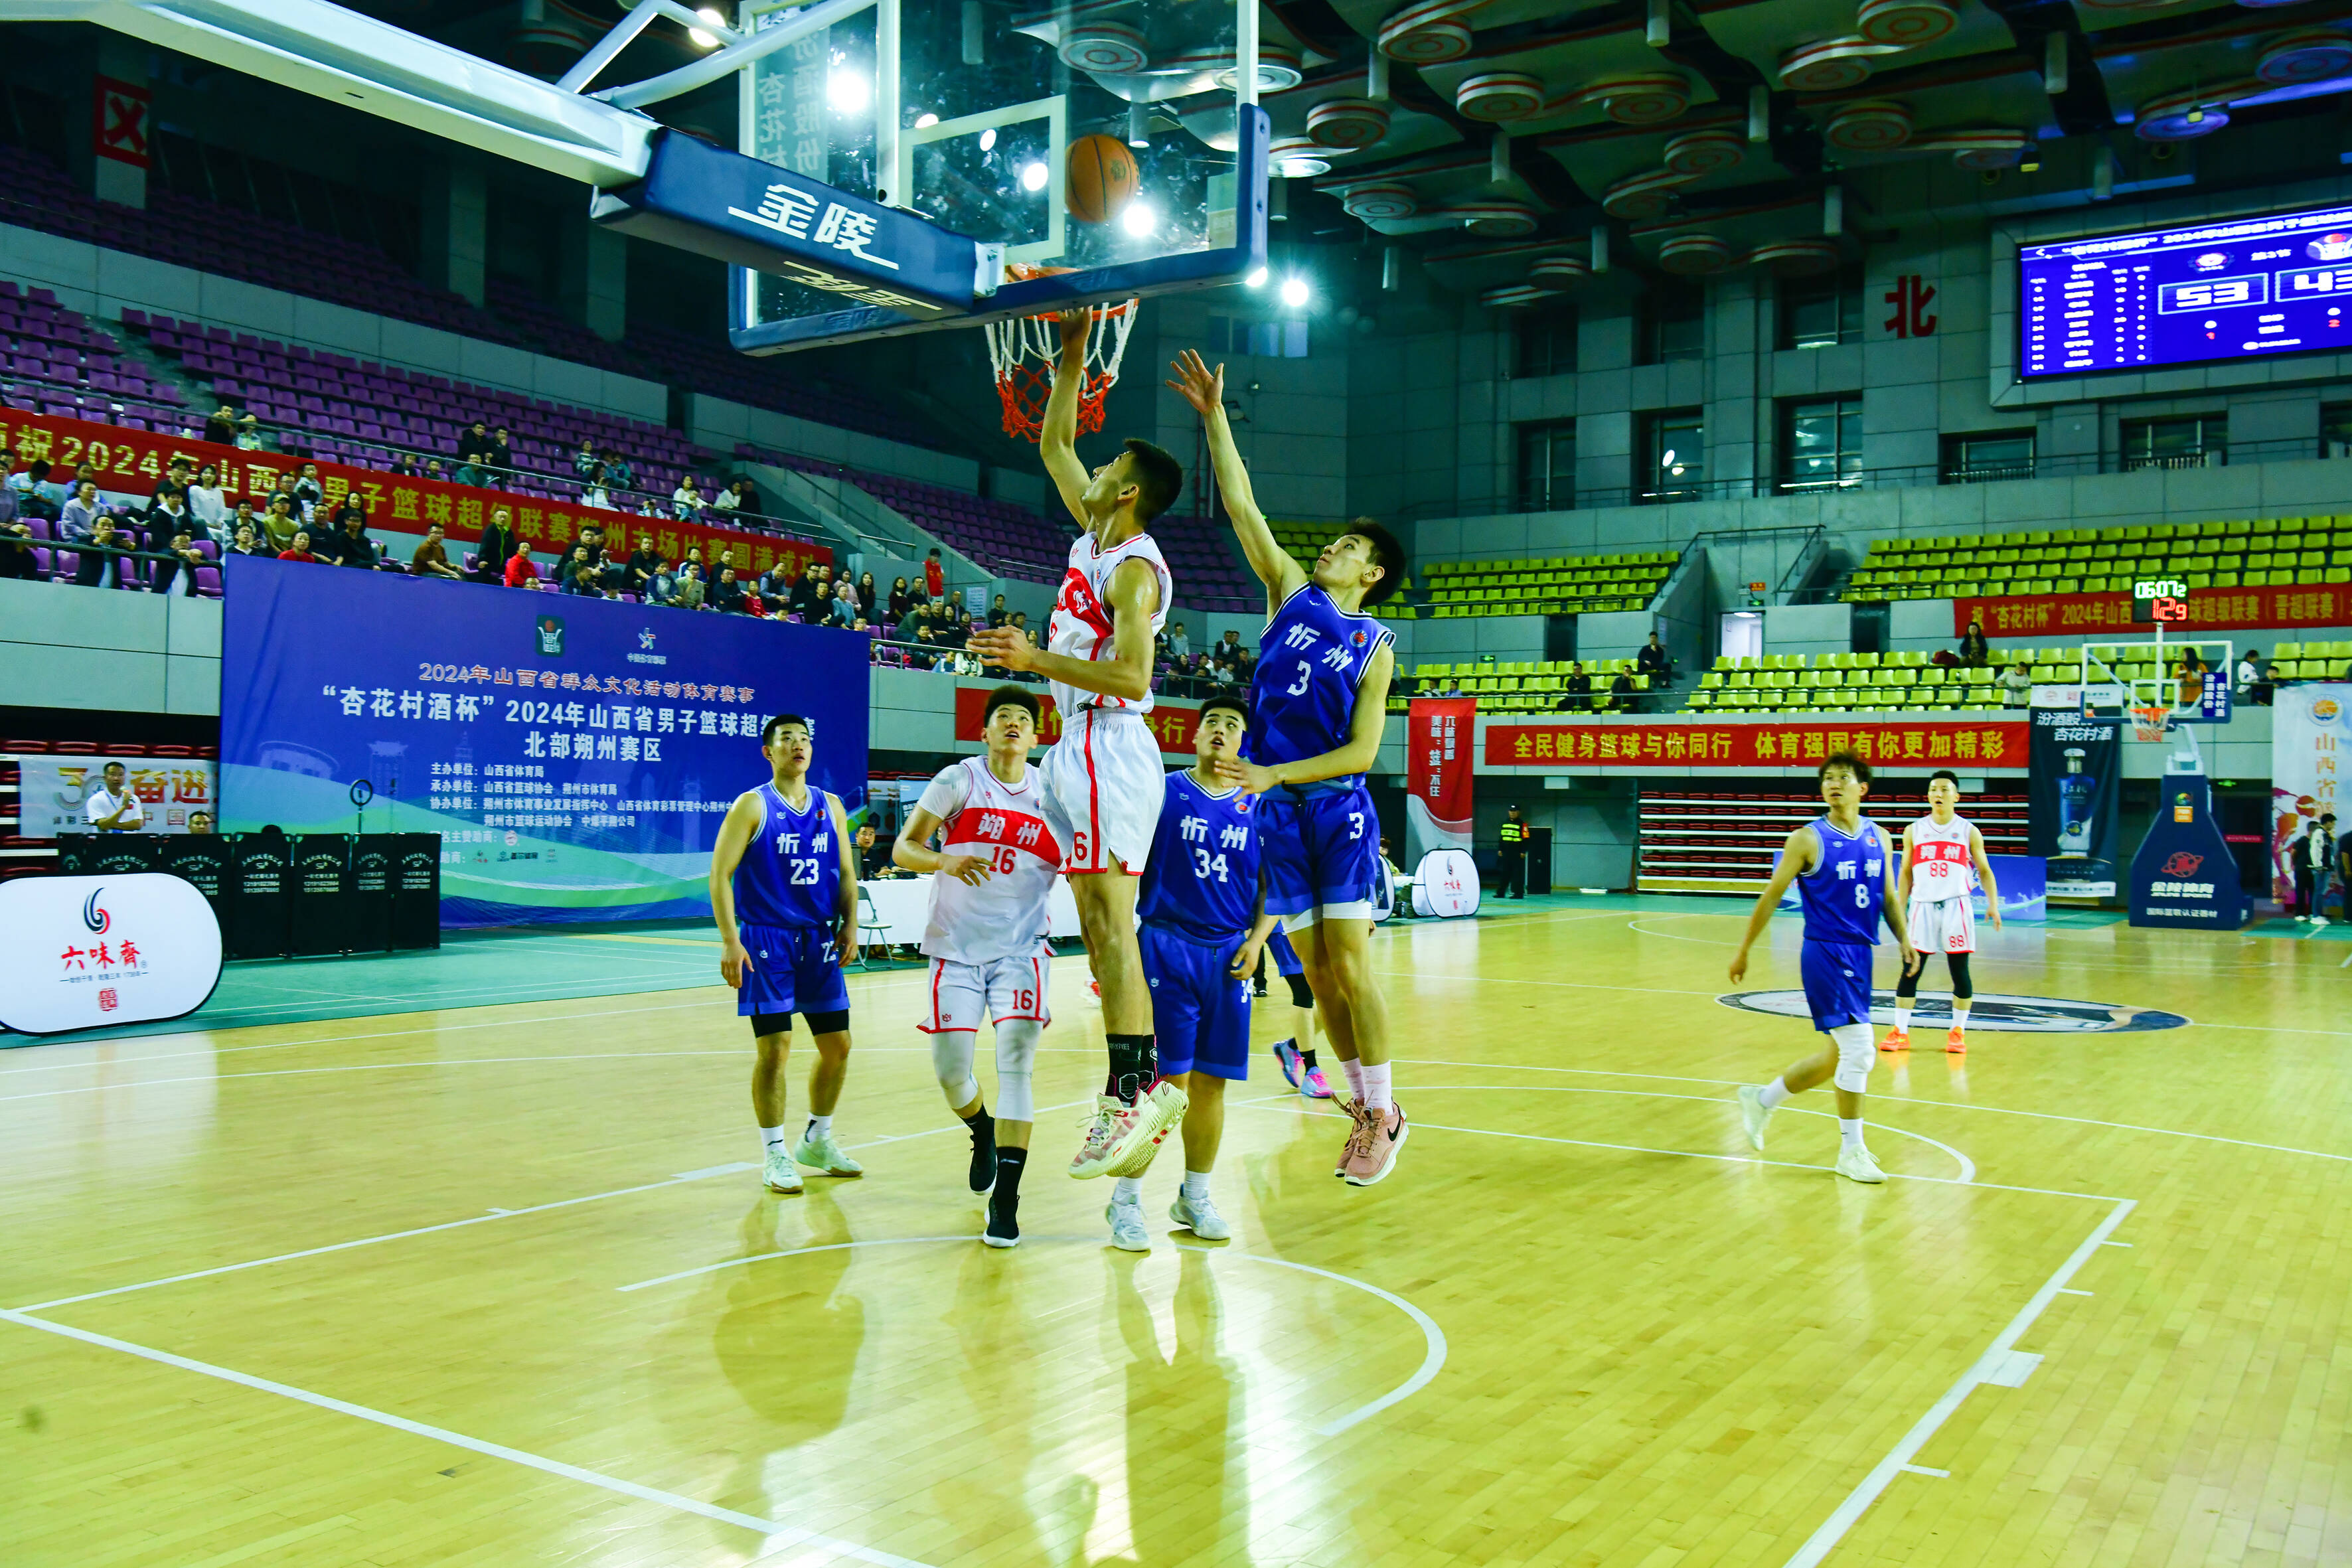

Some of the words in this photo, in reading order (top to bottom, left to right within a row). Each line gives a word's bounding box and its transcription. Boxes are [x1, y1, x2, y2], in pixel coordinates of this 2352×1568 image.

[728, 184, 899, 270] 金陵
[1884, 275, 1937, 339] 北
[2176, 281, 2249, 307] 53
[1285, 622, 1354, 672] 忻州
[419, 663, 755, 704] 2024年山西省群众文化活动体育赛事
[1287, 661, 1312, 696] 3
[323, 685, 495, 722] “杏花村酒杯”
[505, 700, 815, 742] 2024年山西省男子篮球超
[2036, 712, 2093, 726] 汾酒股
[524, 731, 661, 762] 北部朔州赛区
[1514, 732, 1732, 759] 全民健身篮球与你同行
[1755, 731, 2005, 759] 体育强国有你更加精彩
[2054, 726, 2114, 742] 杏花村酒
[484, 764, 544, 778] 山西省体育局
[130, 769, 209, 803] 奋进
[977, 812, 1044, 846] 朔州
[1180, 815, 1249, 851] 忻州
[1349, 812, 1364, 840] 3
[776, 832, 828, 854] 忻州
[1074, 832, 1089, 861] 6
[790, 859, 819, 885] 23
[988, 846, 1016, 875] 16
[1195, 848, 1229, 883] 34
[1836, 858, 1883, 880] 忻州
[1930, 862, 1948, 878] 88
[1854, 884, 1871, 909] 8
[1948, 935, 1965, 948] 88
[1012, 990, 1034, 1010] 16
